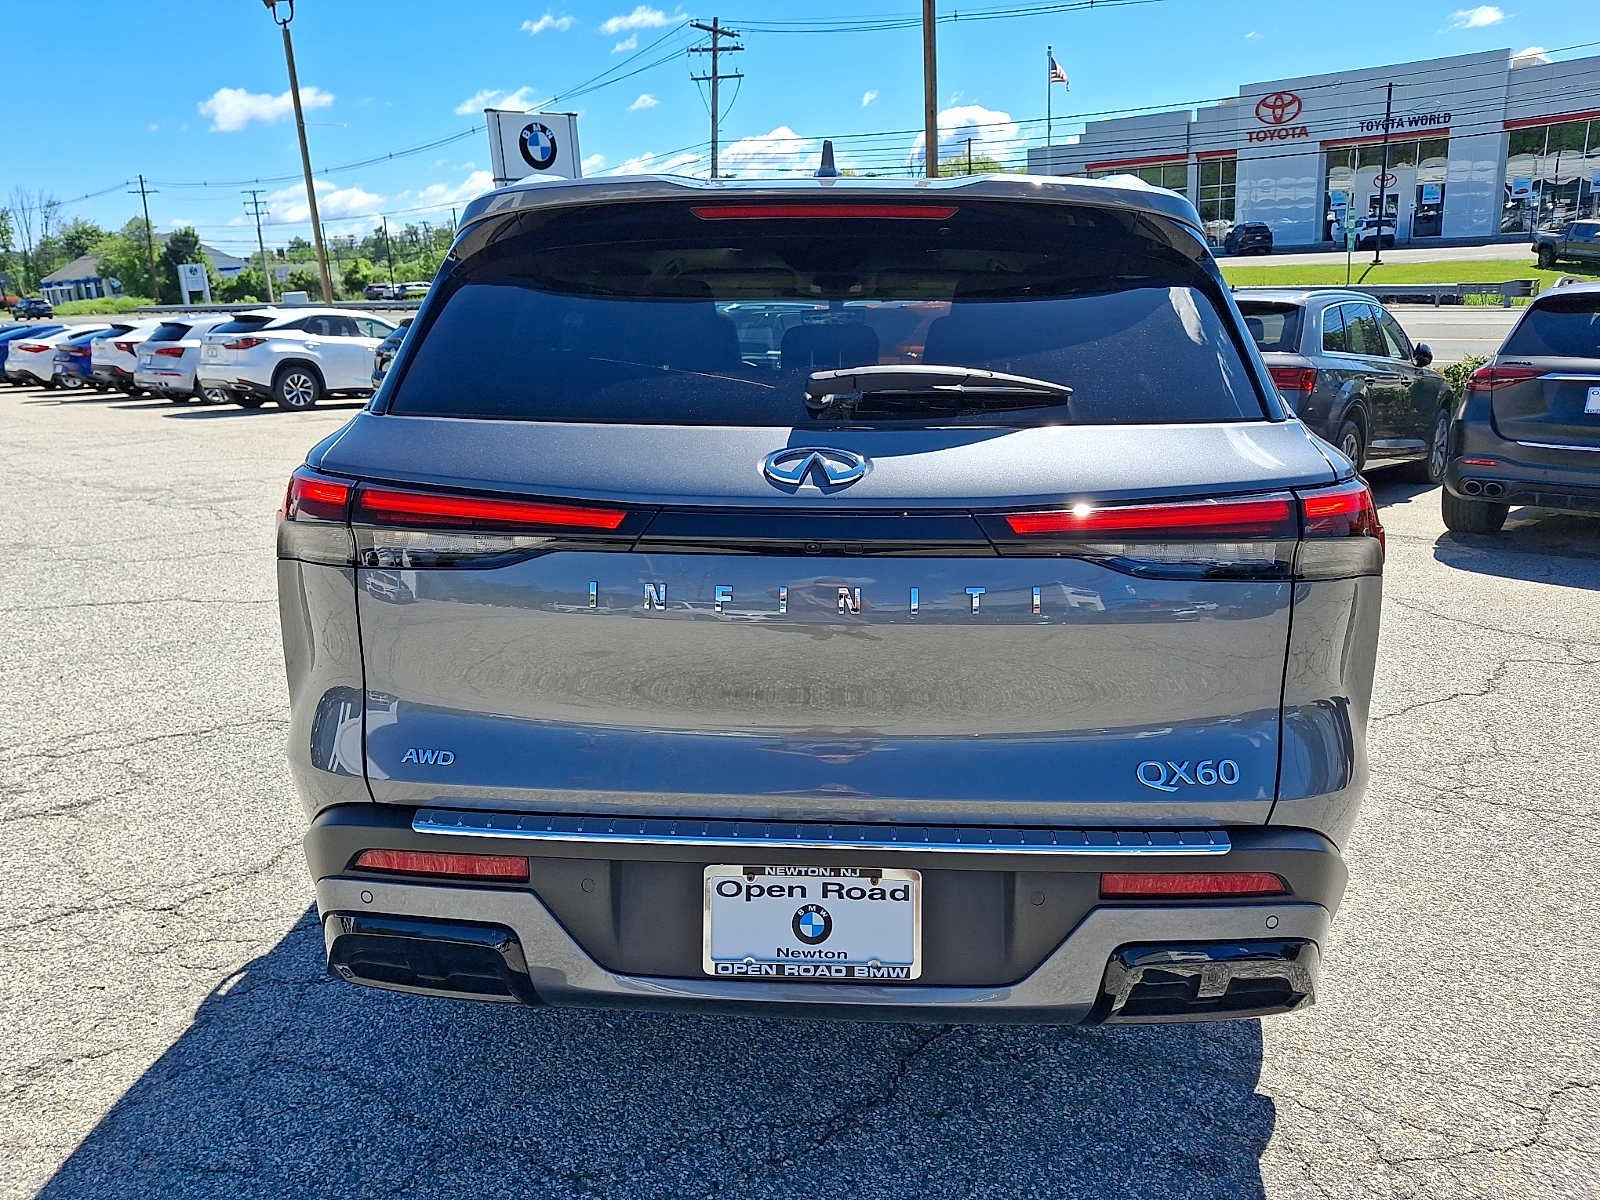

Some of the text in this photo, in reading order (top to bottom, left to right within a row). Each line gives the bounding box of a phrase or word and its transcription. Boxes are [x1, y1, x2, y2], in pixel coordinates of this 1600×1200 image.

[1408, 113, 1452, 127] WORLD
[522, 124, 554, 139] BMW
[1246, 126, 1310, 143] TOYOTA
[589, 580, 1042, 614] INFINITI
[401, 748, 455, 765] AWD
[1136, 759, 1240, 792] QX60
[840, 868, 860, 877] NJ
[716, 880, 910, 901] Open Road
[798, 905, 828, 917] BMW
[776, 947, 848, 960] Newton
[717, 963, 908, 978] OPEN ROAD BMW
